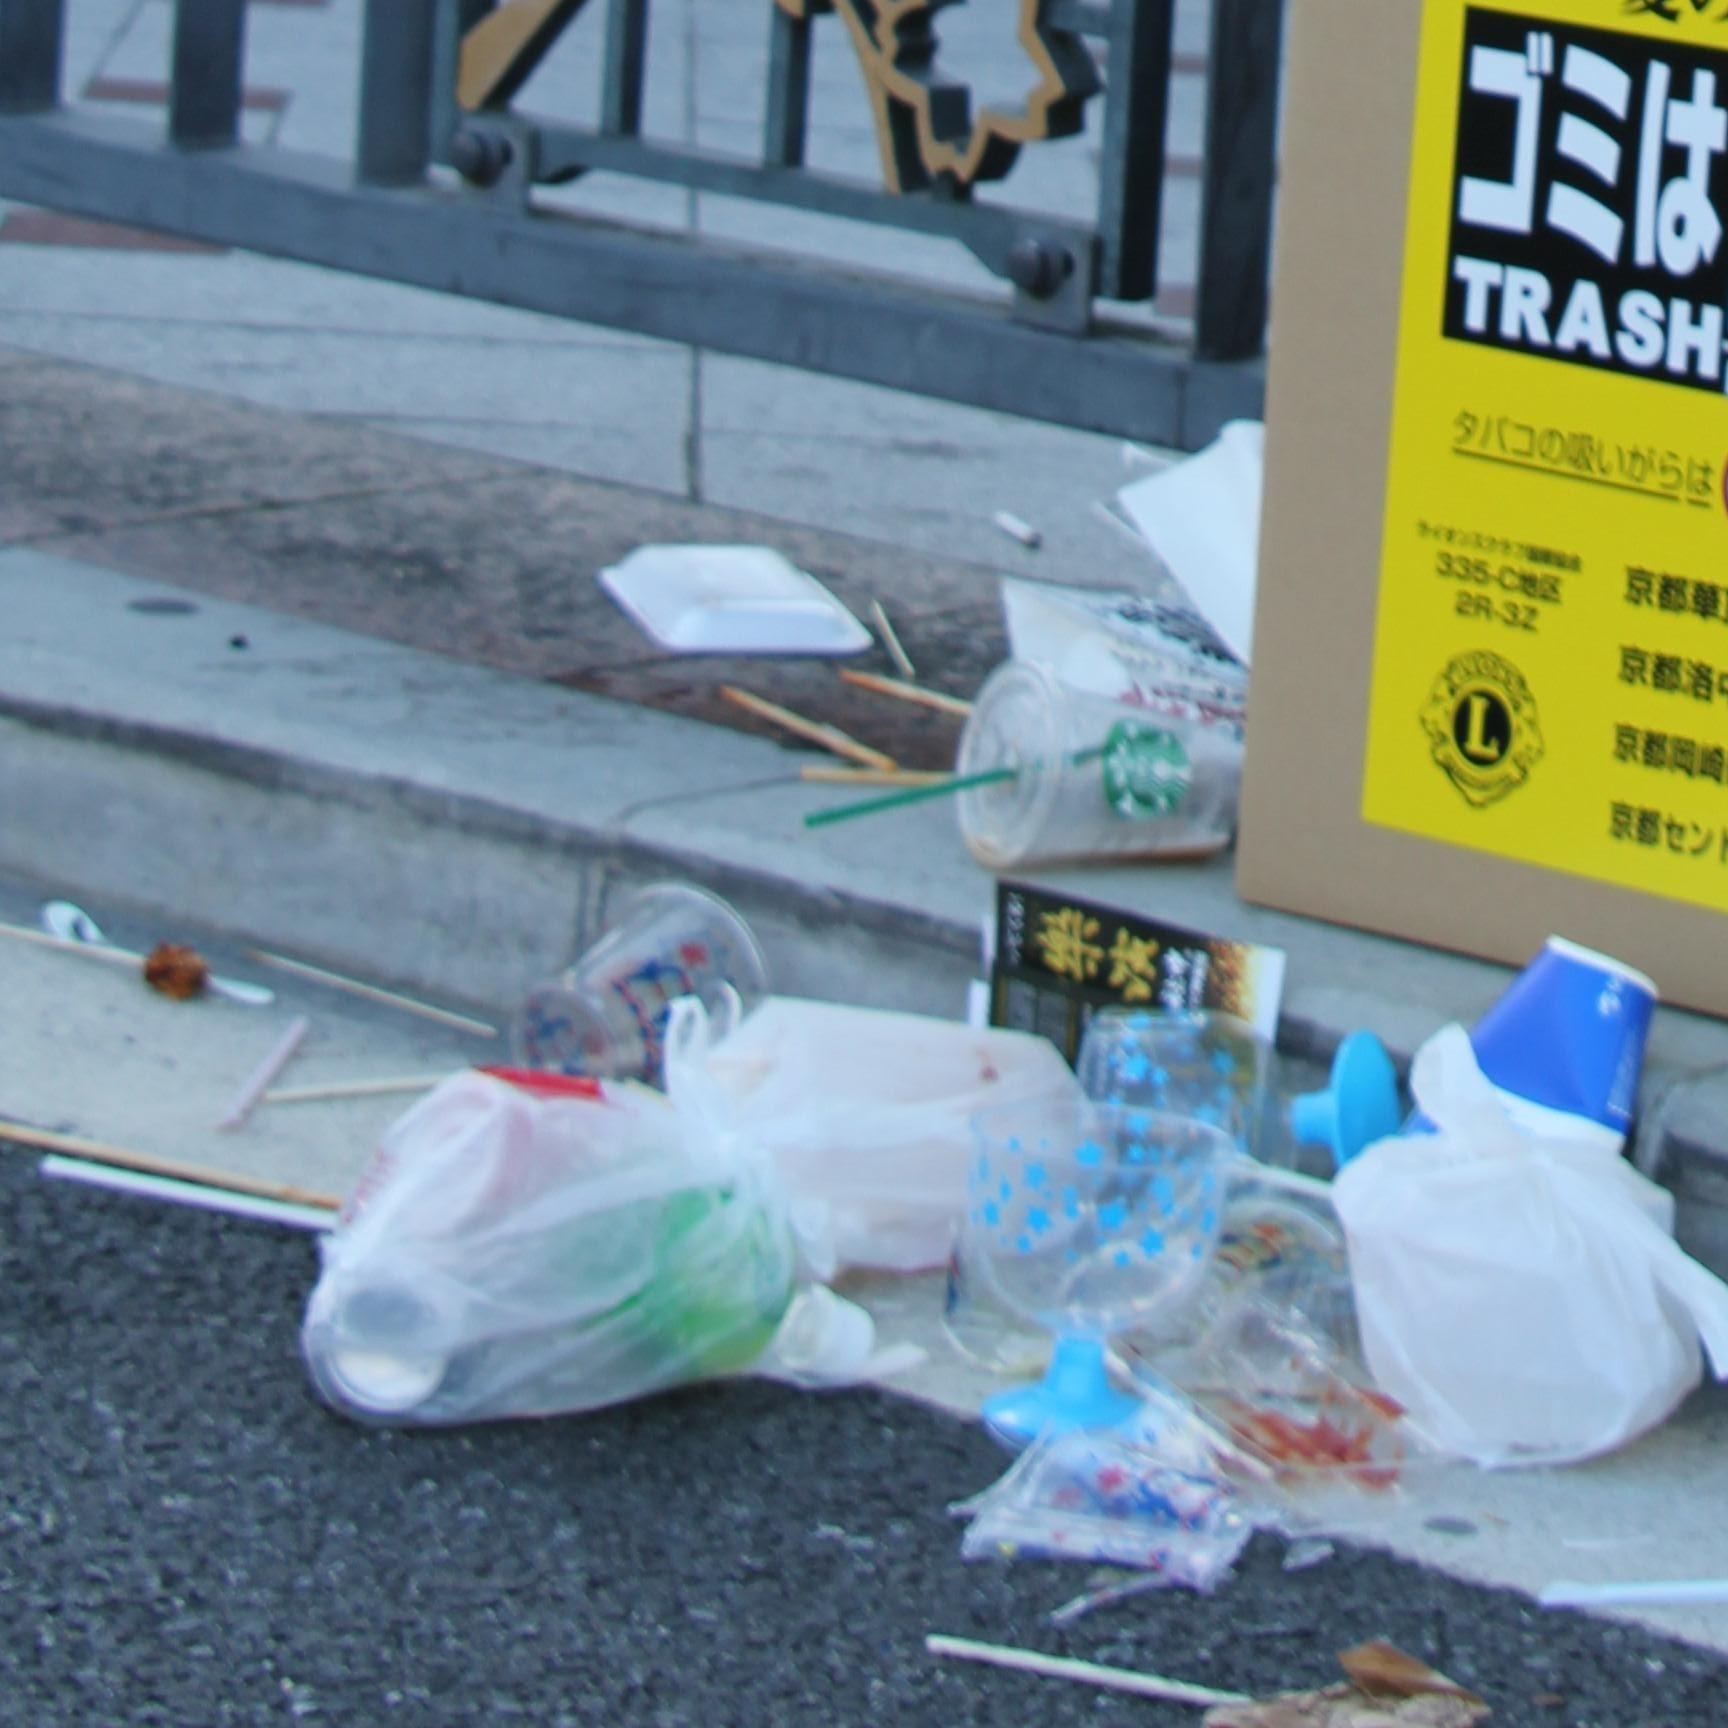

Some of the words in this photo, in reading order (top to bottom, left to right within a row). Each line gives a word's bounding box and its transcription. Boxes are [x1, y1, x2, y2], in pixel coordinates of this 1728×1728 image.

[1459, 31, 1728, 275] ゴミは
[1455, 255, 1722, 380] TRASH
[1453, 409, 1716, 497] タバコの吸いがらは
